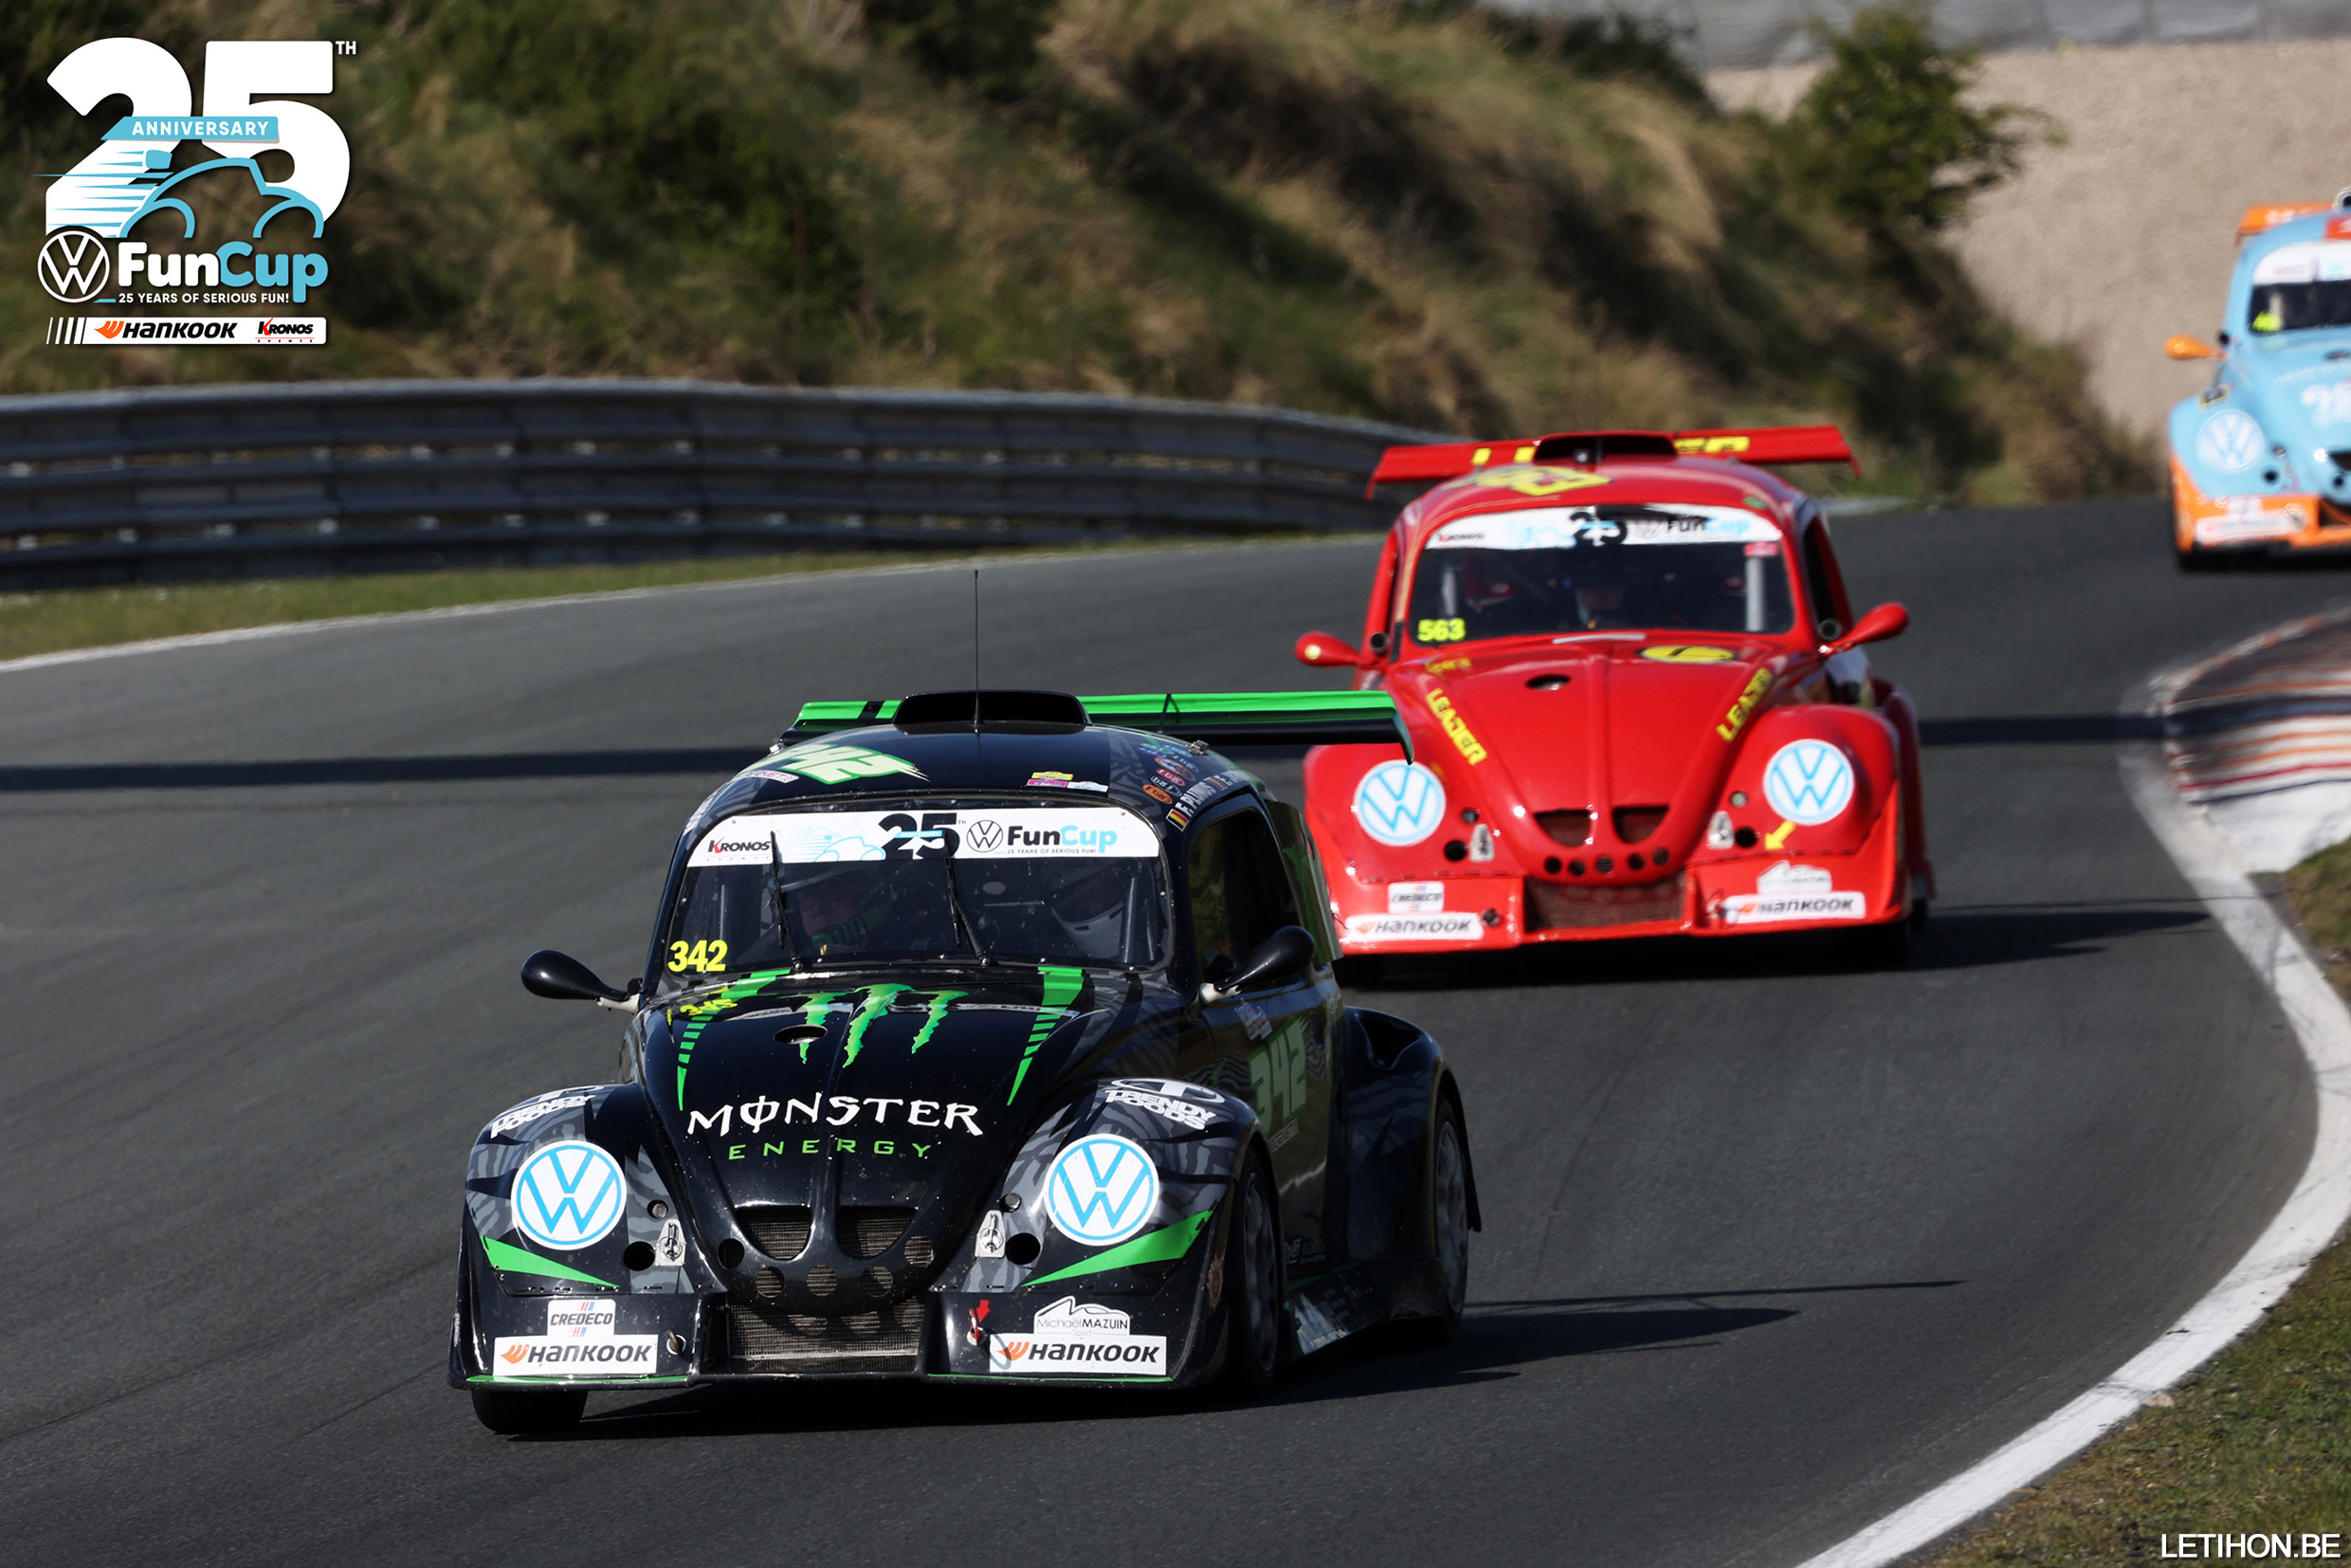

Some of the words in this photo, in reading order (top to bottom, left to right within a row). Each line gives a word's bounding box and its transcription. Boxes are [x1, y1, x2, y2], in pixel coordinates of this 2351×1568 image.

[1417, 618, 1467, 642] 563
[708, 837, 771, 853] KRONOS
[879, 813, 960, 861] 25
[1008, 825, 1118, 853] FunCup
[667, 939, 728, 973] 342
[1248, 1016, 1307, 1135] 342
[1104, 1089, 1216, 1121] TRENDY
[729, 1139, 931, 1160] ENERGY
[550, 1313, 613, 1326] CREDECO
